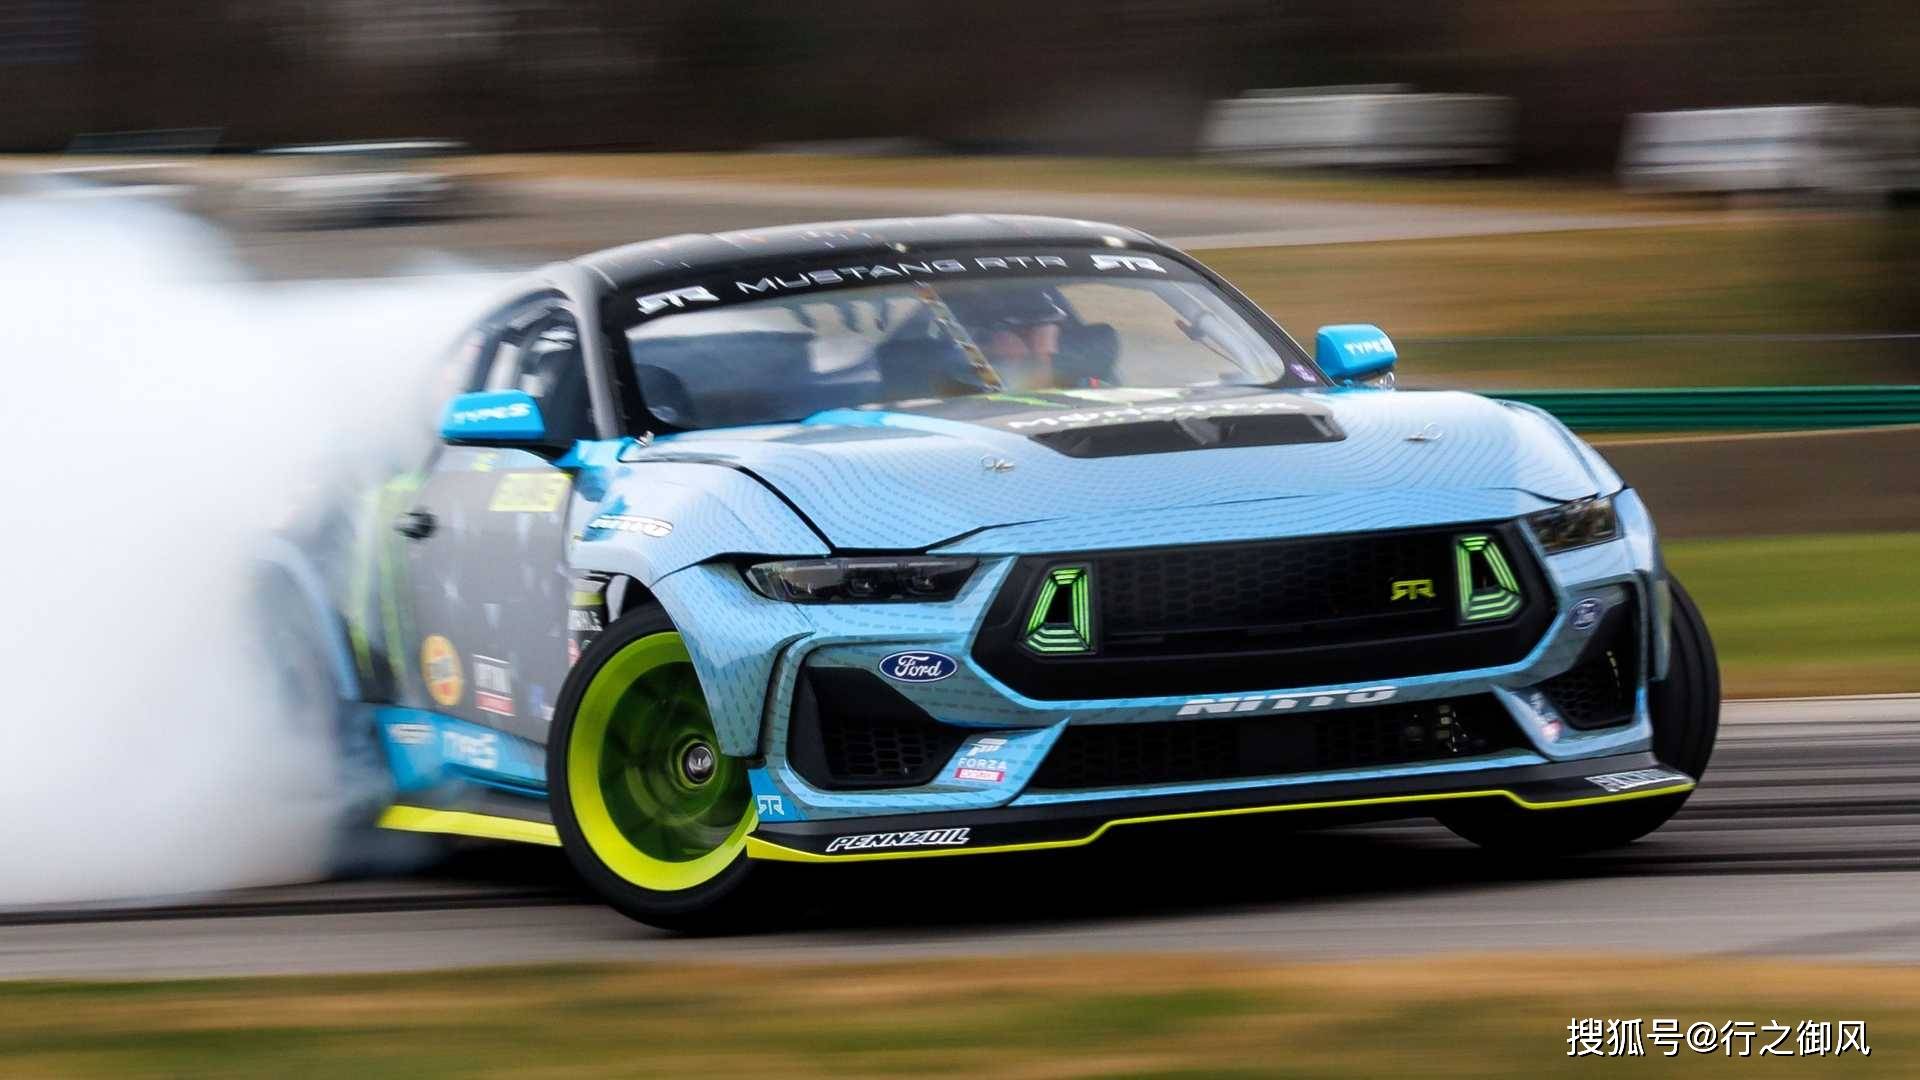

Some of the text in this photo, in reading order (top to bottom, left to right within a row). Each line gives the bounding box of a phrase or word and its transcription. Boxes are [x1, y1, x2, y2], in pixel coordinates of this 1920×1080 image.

[735, 255, 1069, 295] MUSTANG RTR
[894, 655, 942, 677] Ford
[1176, 685, 1398, 717] NITTO
[958, 757, 1008, 770] FORZA
[826, 827, 971, 853] PENNZOIL
